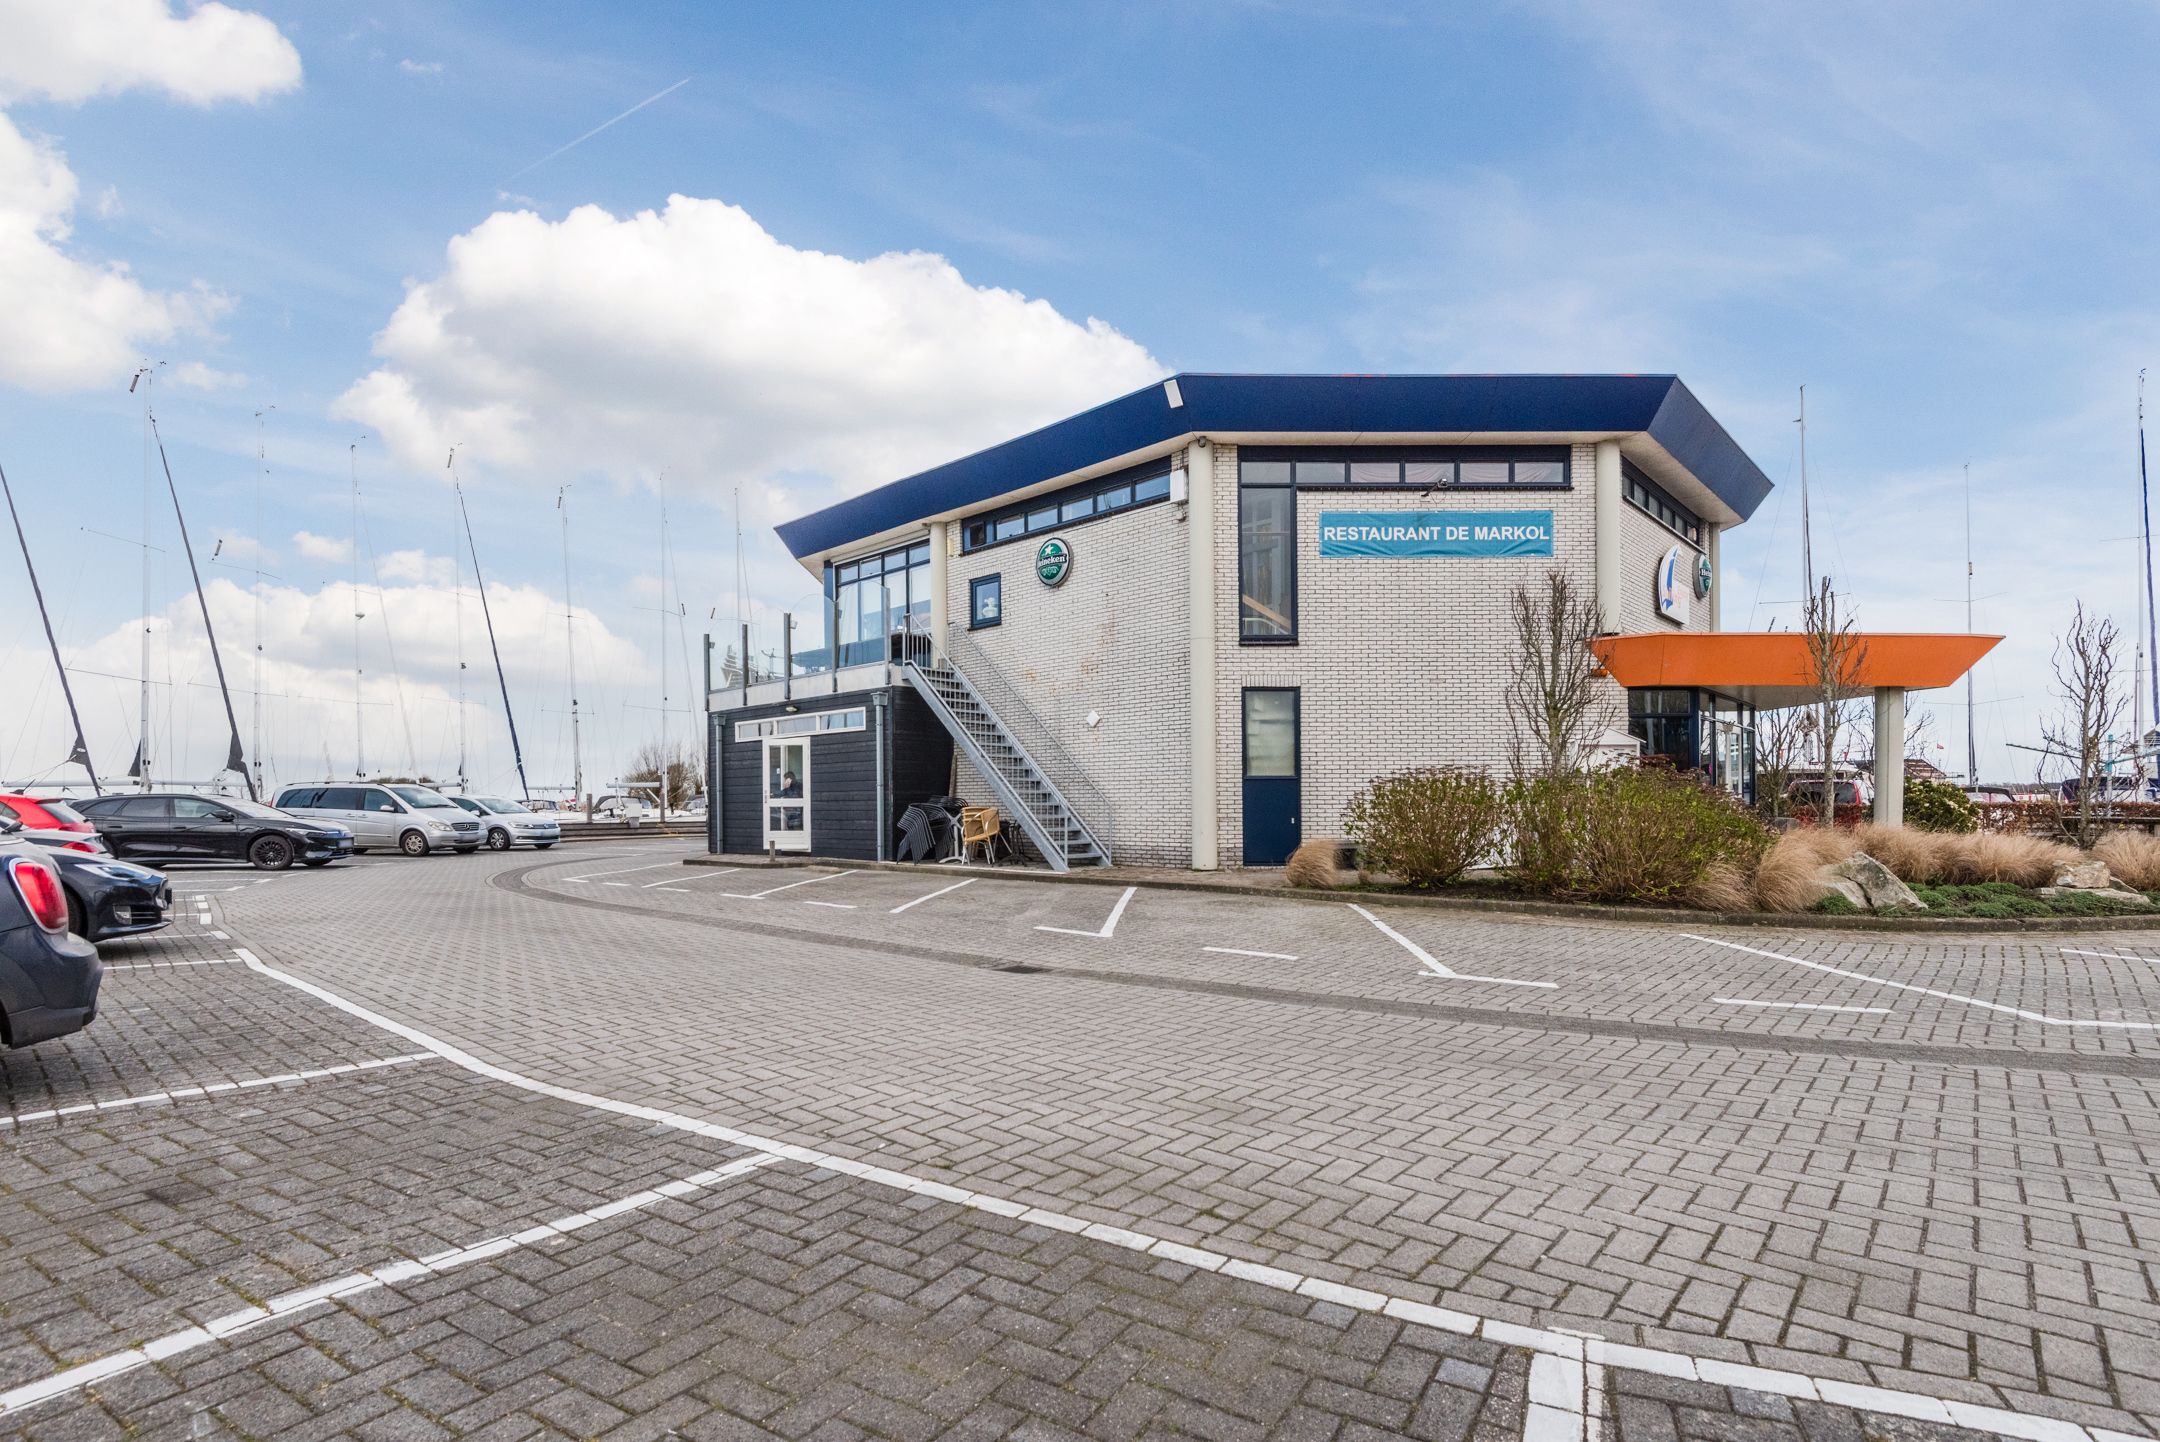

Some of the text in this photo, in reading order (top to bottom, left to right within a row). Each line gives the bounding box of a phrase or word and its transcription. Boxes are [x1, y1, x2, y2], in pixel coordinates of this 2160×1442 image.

[1324, 525, 1550, 541] RESTAURANT DE MARKOL
